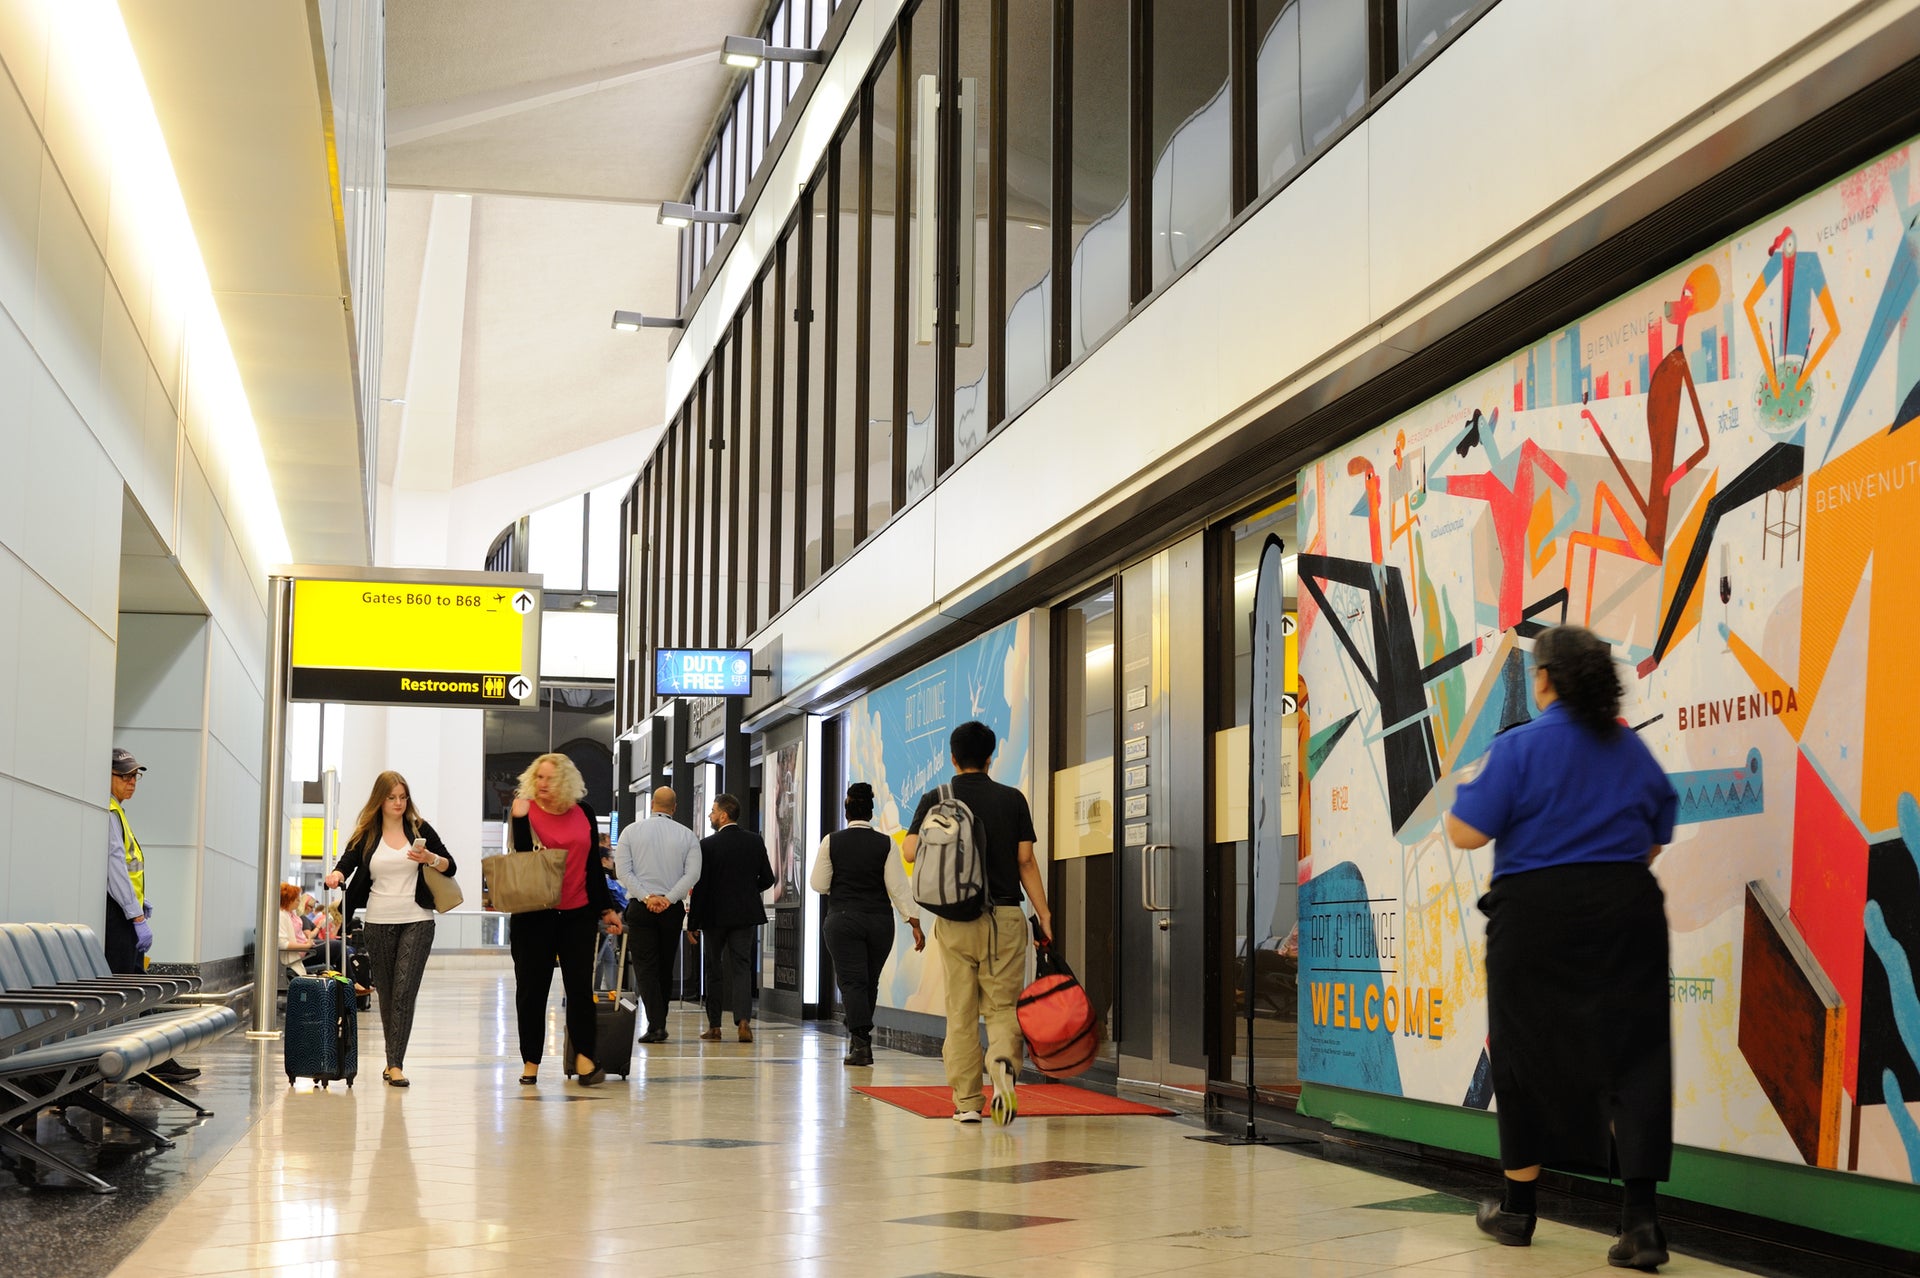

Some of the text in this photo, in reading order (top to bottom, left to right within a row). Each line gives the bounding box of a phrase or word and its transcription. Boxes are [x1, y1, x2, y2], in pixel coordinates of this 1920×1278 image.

[1817, 204, 1879, 243] VELKOMMEN
[1587, 311, 1655, 361] BIENVENUE
[1816, 460, 1920, 513] BENVENUT
[362, 591, 481, 607] Gates B60 to B68
[683, 655, 726, 673] DUTY
[683, 673, 725, 690] FREE
[401, 678, 480, 693] Restrooms
[1678, 687, 1798, 731] BIENVENIDA
[1311, 912, 1396, 959] ART & LOUNGE
[1310, 982, 1443, 1040] WELCOME
